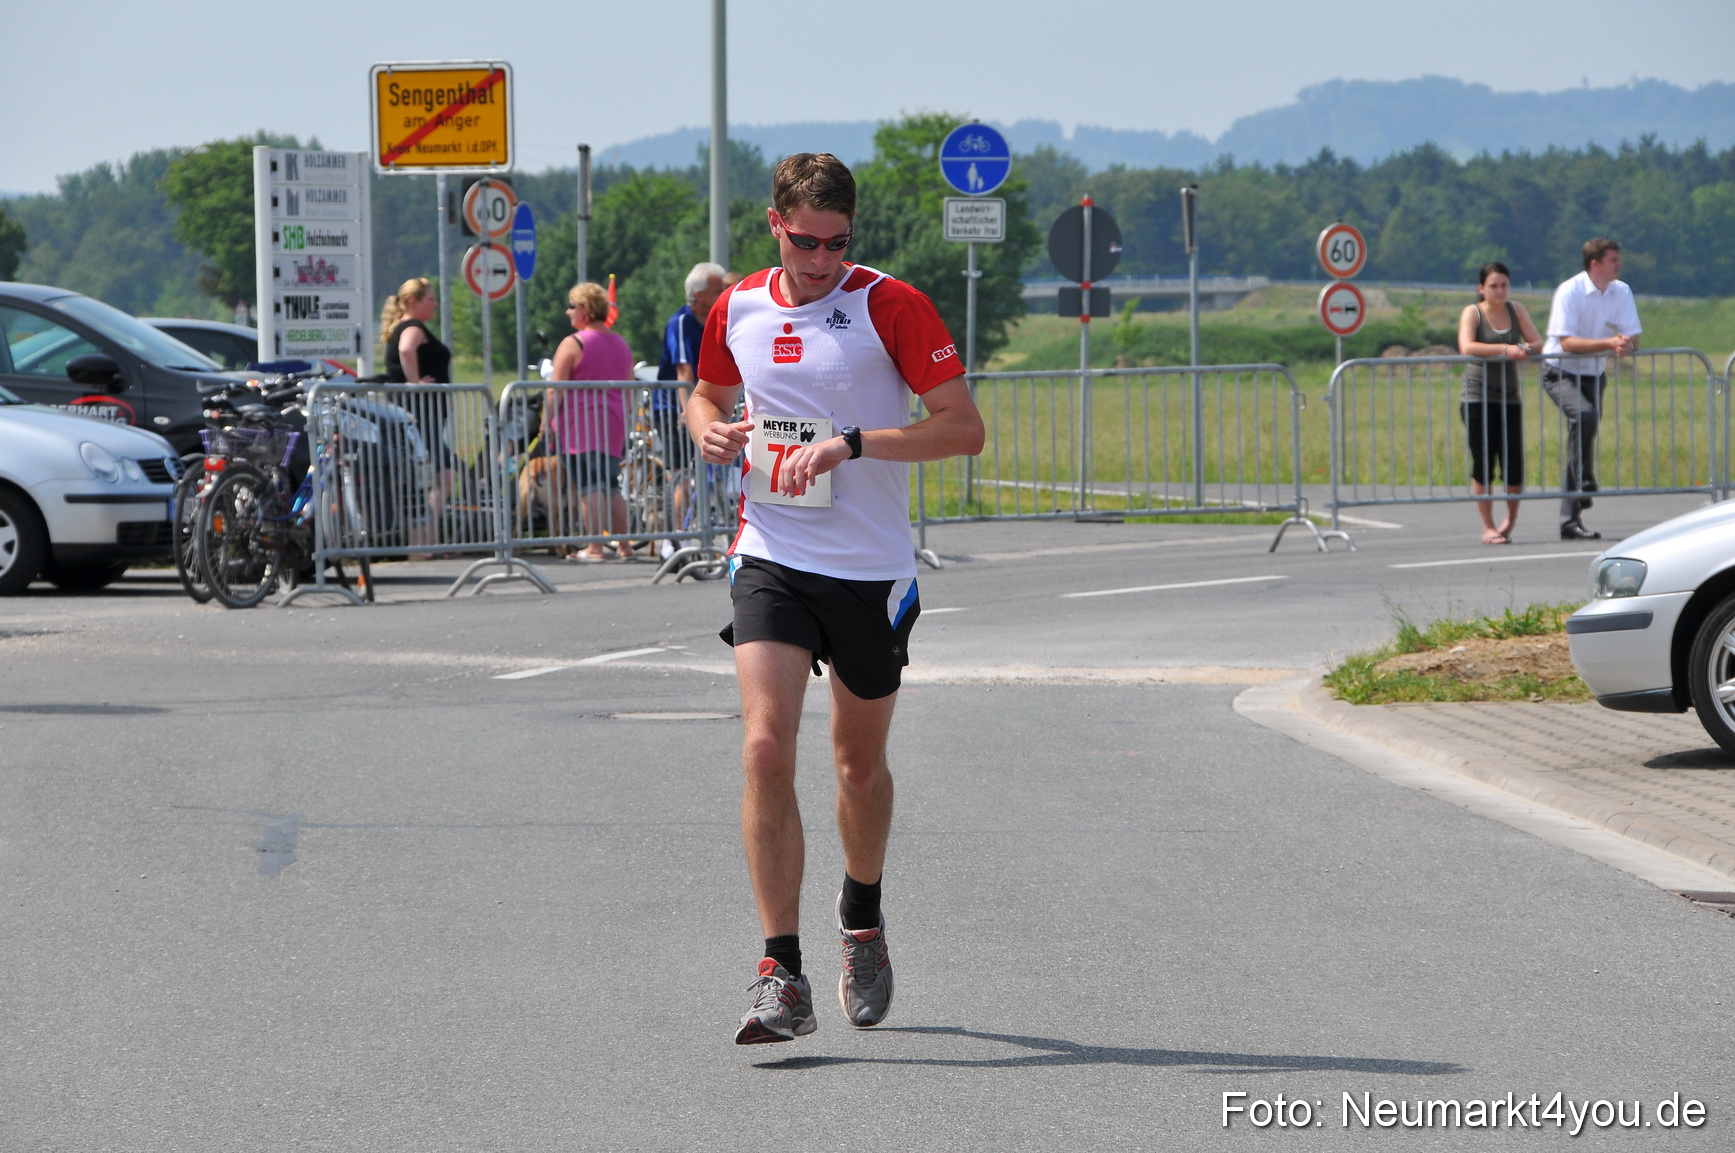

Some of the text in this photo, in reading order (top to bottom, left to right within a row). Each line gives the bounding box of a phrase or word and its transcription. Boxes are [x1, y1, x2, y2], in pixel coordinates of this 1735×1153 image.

[389, 81, 494, 112] Sengenthal
[403, 113, 480, 131] am Anger
[415, 142, 462, 153] Neumarkt
[1332, 239, 1356, 263] 60
[284, 296, 320, 319] THULE
[763, 420, 797, 432] MEYER
[763, 431, 797, 440] WERBUNG
